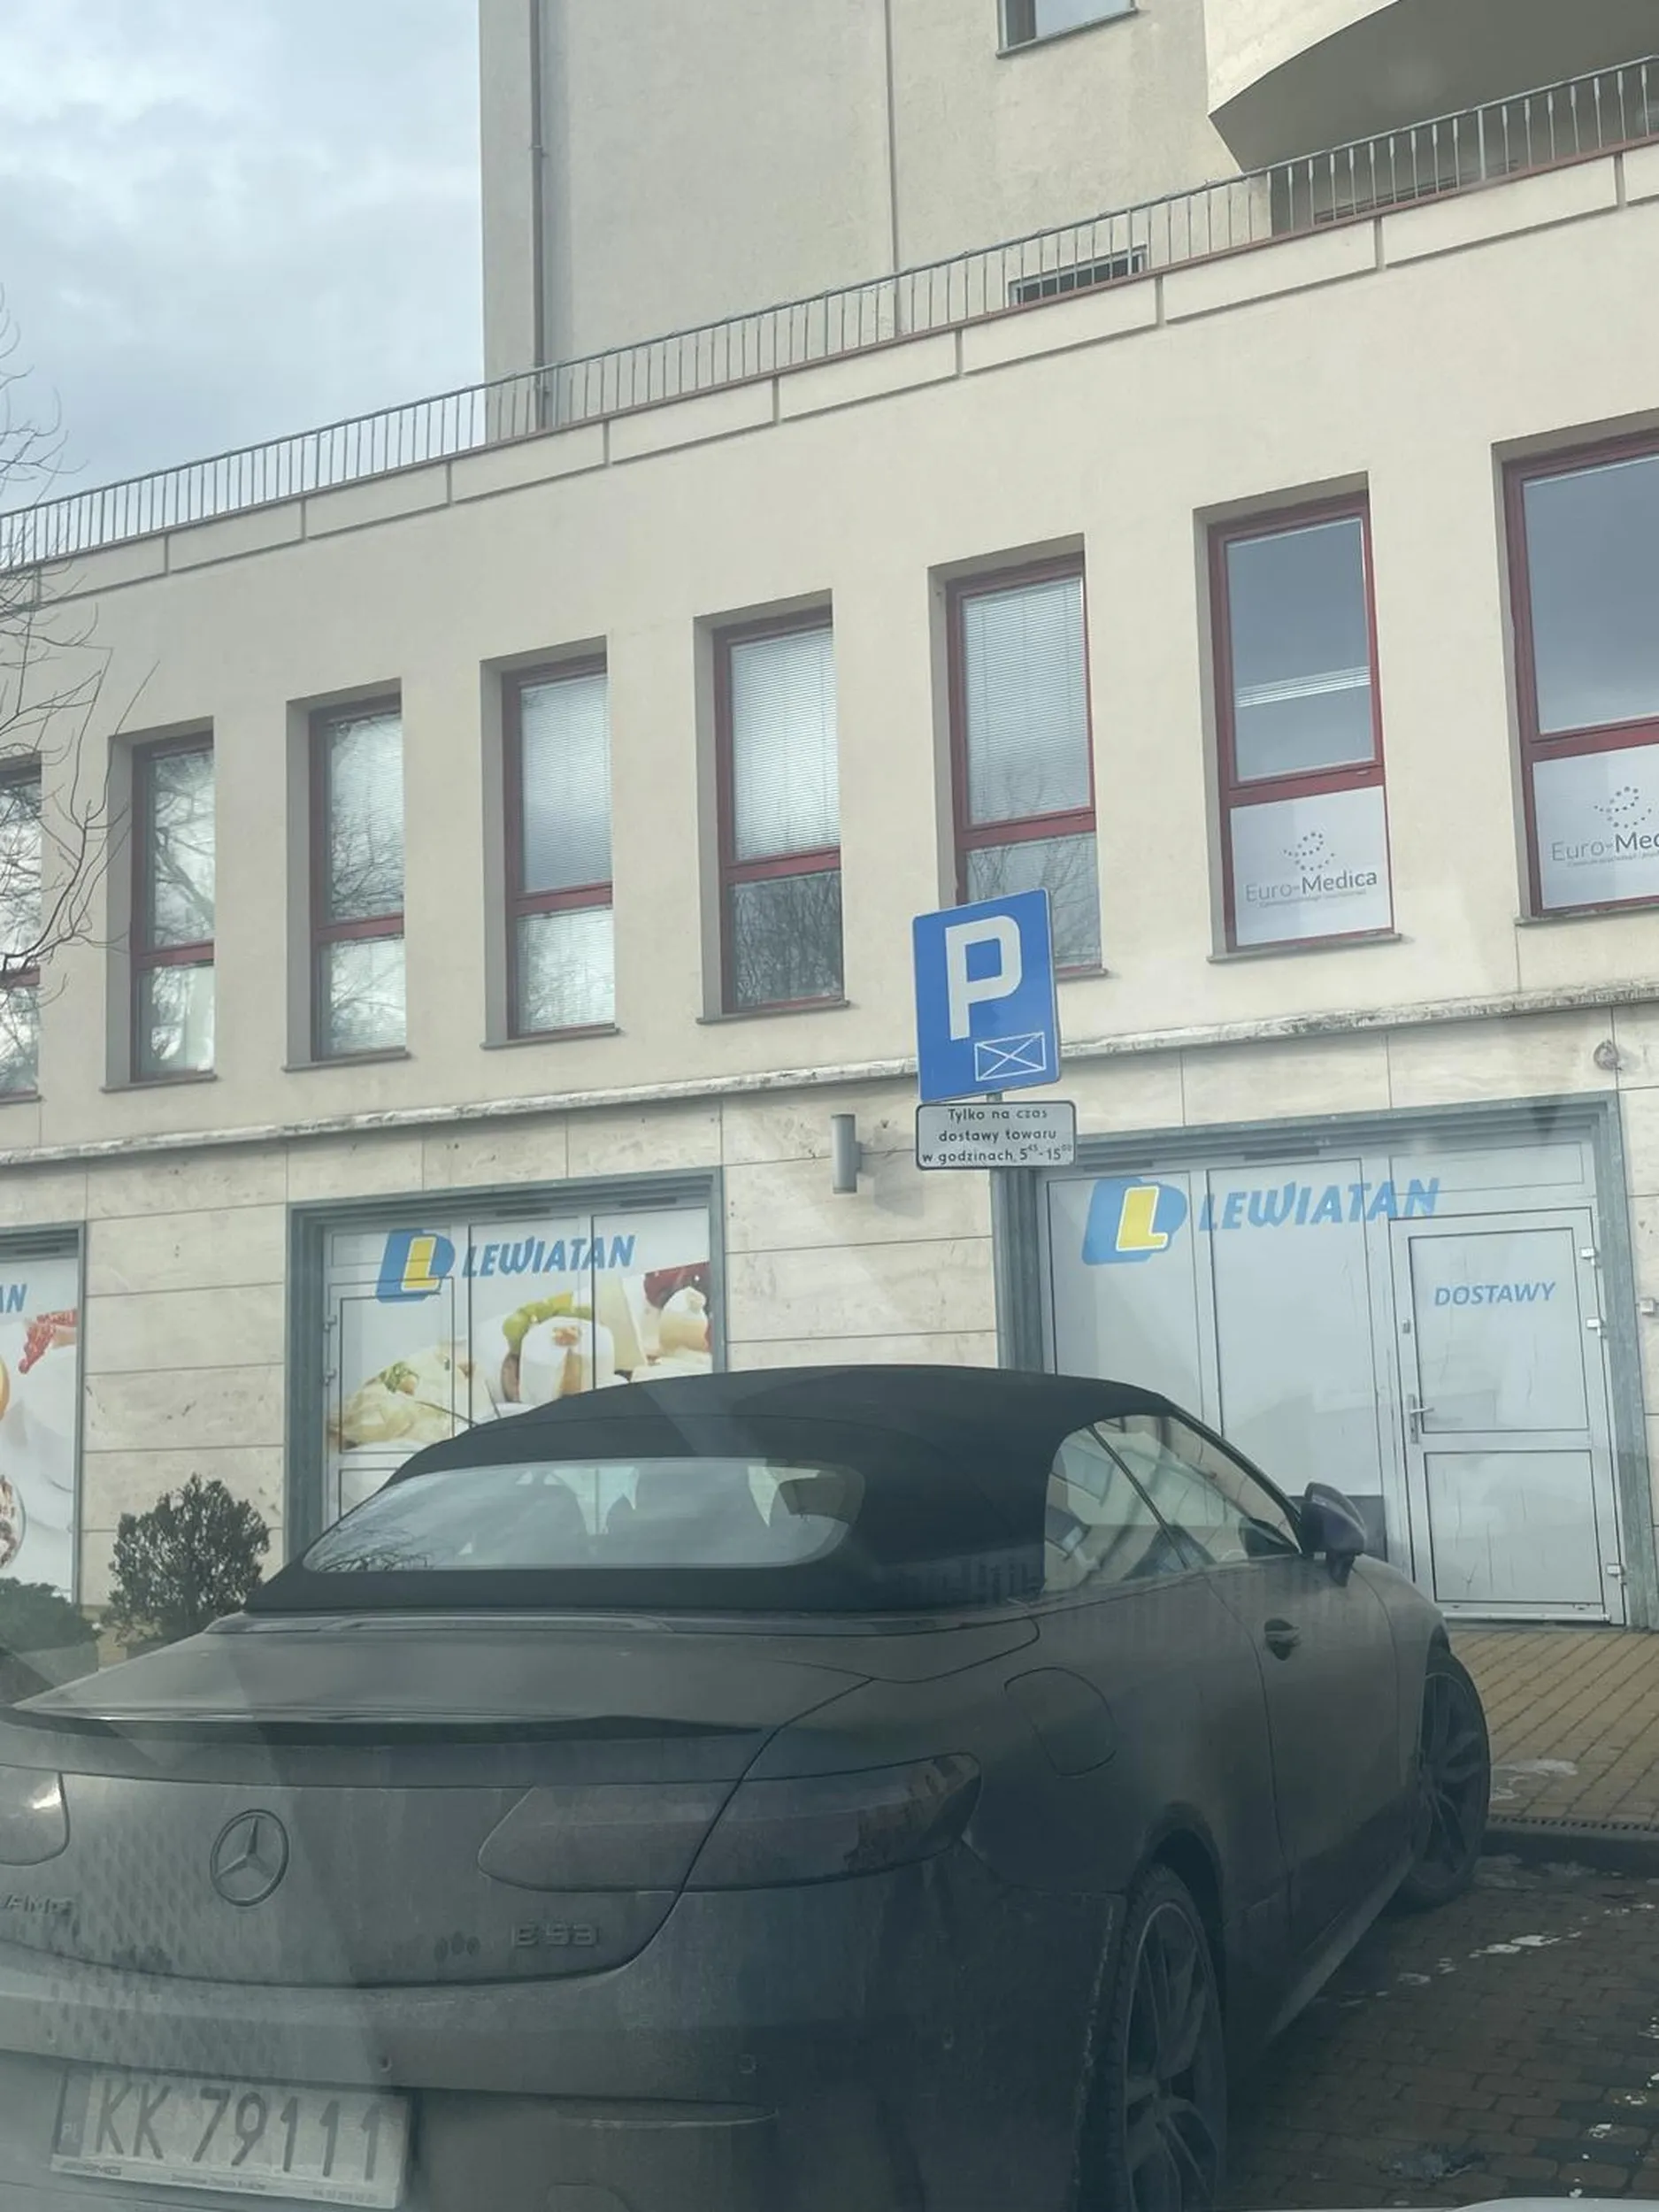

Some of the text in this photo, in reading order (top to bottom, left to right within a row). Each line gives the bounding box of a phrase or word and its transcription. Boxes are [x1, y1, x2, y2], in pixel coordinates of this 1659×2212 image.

[1245, 870, 1378, 902] Euro-Medica
[945, 915, 1022, 1041] P
[949, 1108, 1048, 1124] Tylko na czas
[938, 1129, 1057, 1144] dostawy towaru
[921, 1153, 933, 1163] w
[1198, 1178, 1440, 1233] LEWIATAN
[462, 1234, 635, 1279] LEWIATAN
[1434, 1281, 1556, 1306] DOSTAWY
[95, 2077, 382, 2182] KK 79111
